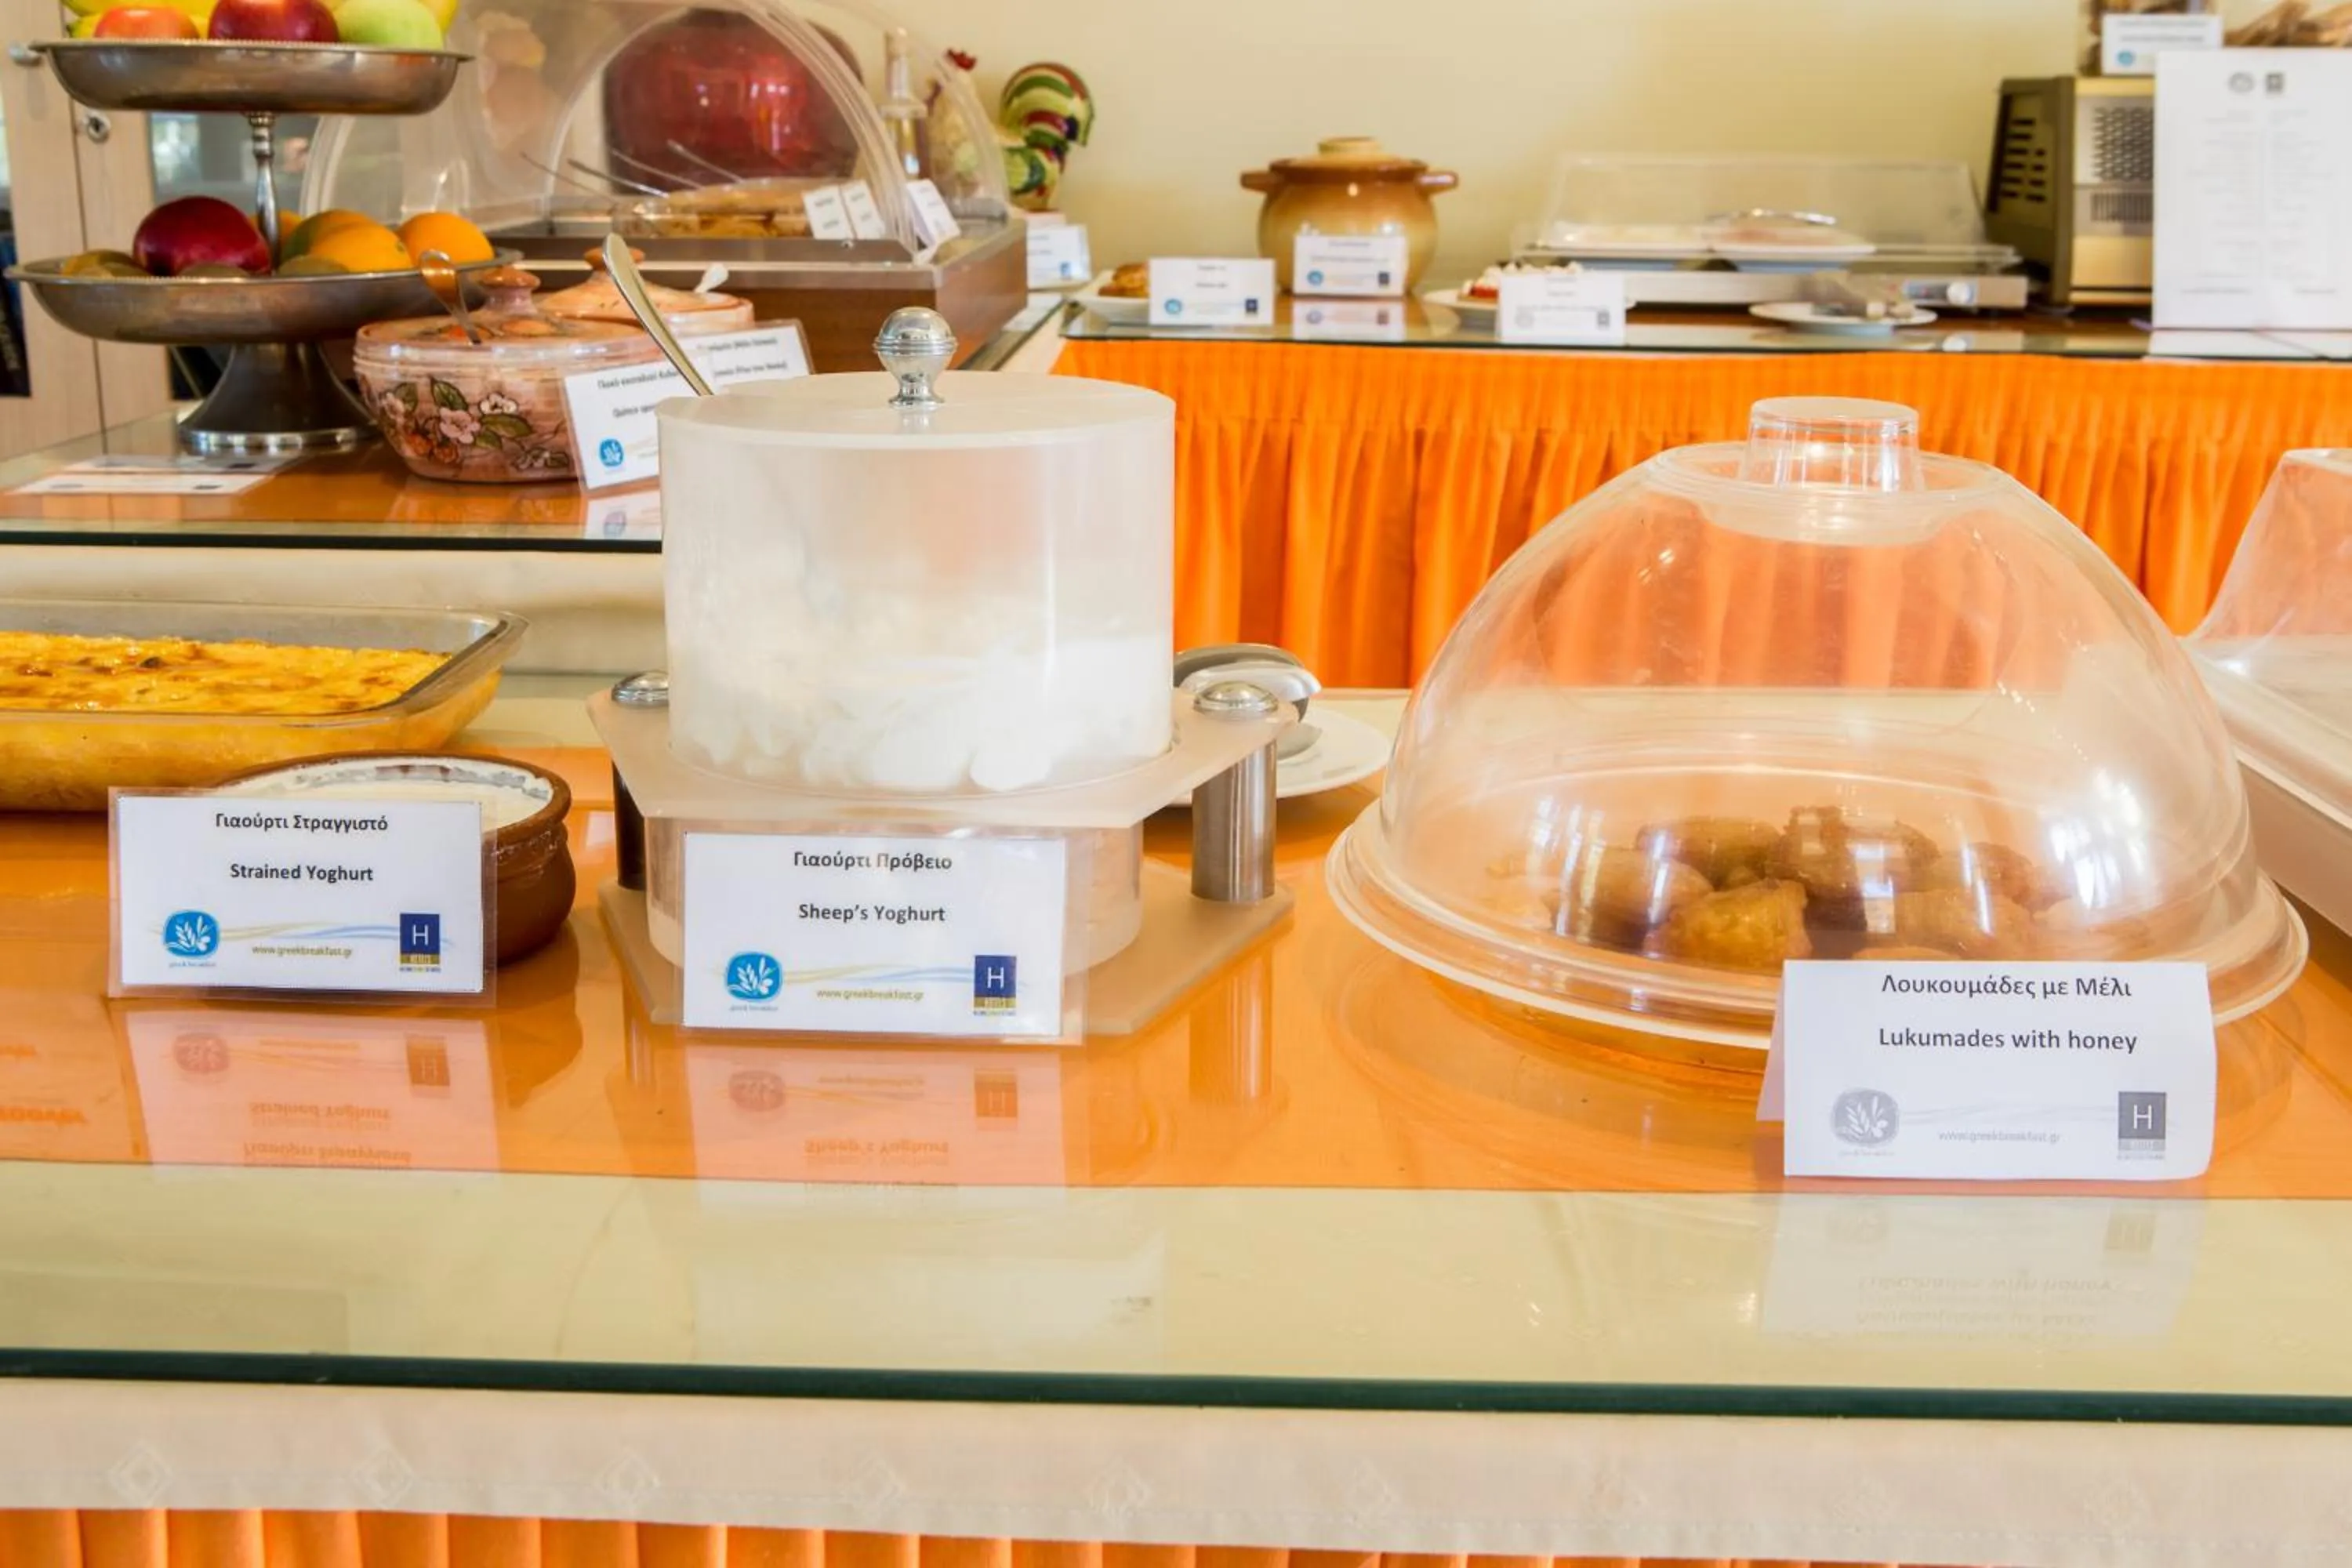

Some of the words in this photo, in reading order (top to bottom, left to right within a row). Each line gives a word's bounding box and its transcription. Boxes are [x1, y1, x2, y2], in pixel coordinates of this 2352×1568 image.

[216, 812, 289, 833] Γιαούρτι
[292, 814, 389, 834] Στραγγιστό
[793, 850, 871, 871] Γιαούρτι
[877, 852, 953, 873] Πρόβειο
[230, 863, 302, 880] Strained
[306, 865, 374, 884] Yoghurt
[873, 905, 946, 925] Yoghurt
[412, 924, 429, 946] H
[252, 946, 353, 960] www.greekbreakfast.gr
[987, 966, 1004, 989] H
[1881, 974, 2036, 1000] Λουκουμάδες
[2042, 981, 2069, 1000] με
[2075, 976, 2132, 996] Μέλι
[816, 988, 924, 1004] www.greekbreakfast.gr
[1879, 1027, 2005, 1049] Lukumades
[2011, 1029, 2060, 1049] with
[2068, 1029, 2138, 1054] honey
[2132, 1104, 2153, 1130] H
